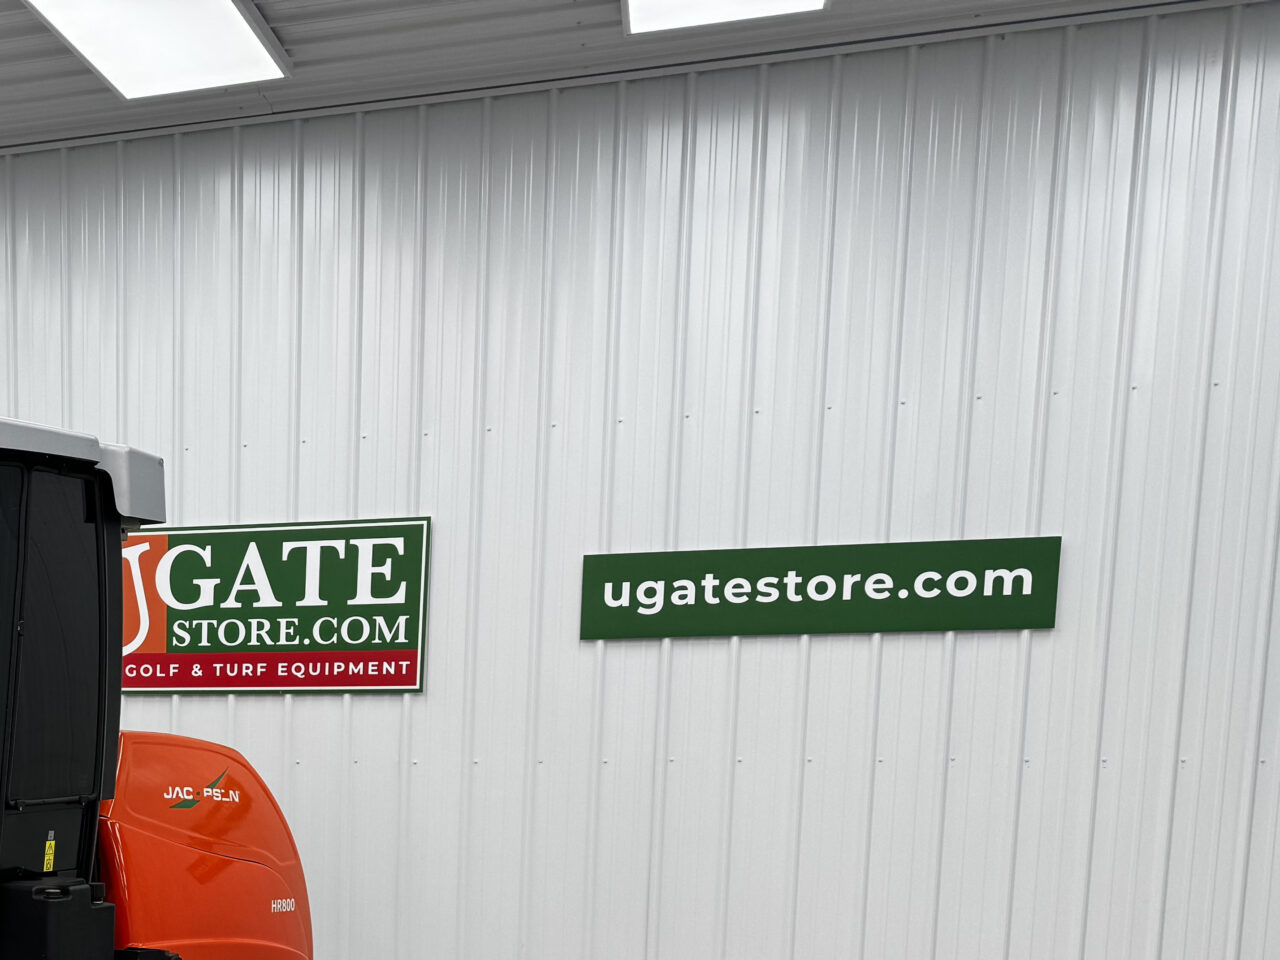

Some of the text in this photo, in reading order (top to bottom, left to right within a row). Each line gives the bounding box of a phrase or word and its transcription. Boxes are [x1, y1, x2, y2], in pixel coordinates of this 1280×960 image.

[603, 566, 1034, 615] ugatestore.com
[172, 615, 410, 647] STORE.COM
[124, 661, 411, 678] GOLF & TURF EQUIPMENT
[271, 898, 296, 913] HR800
